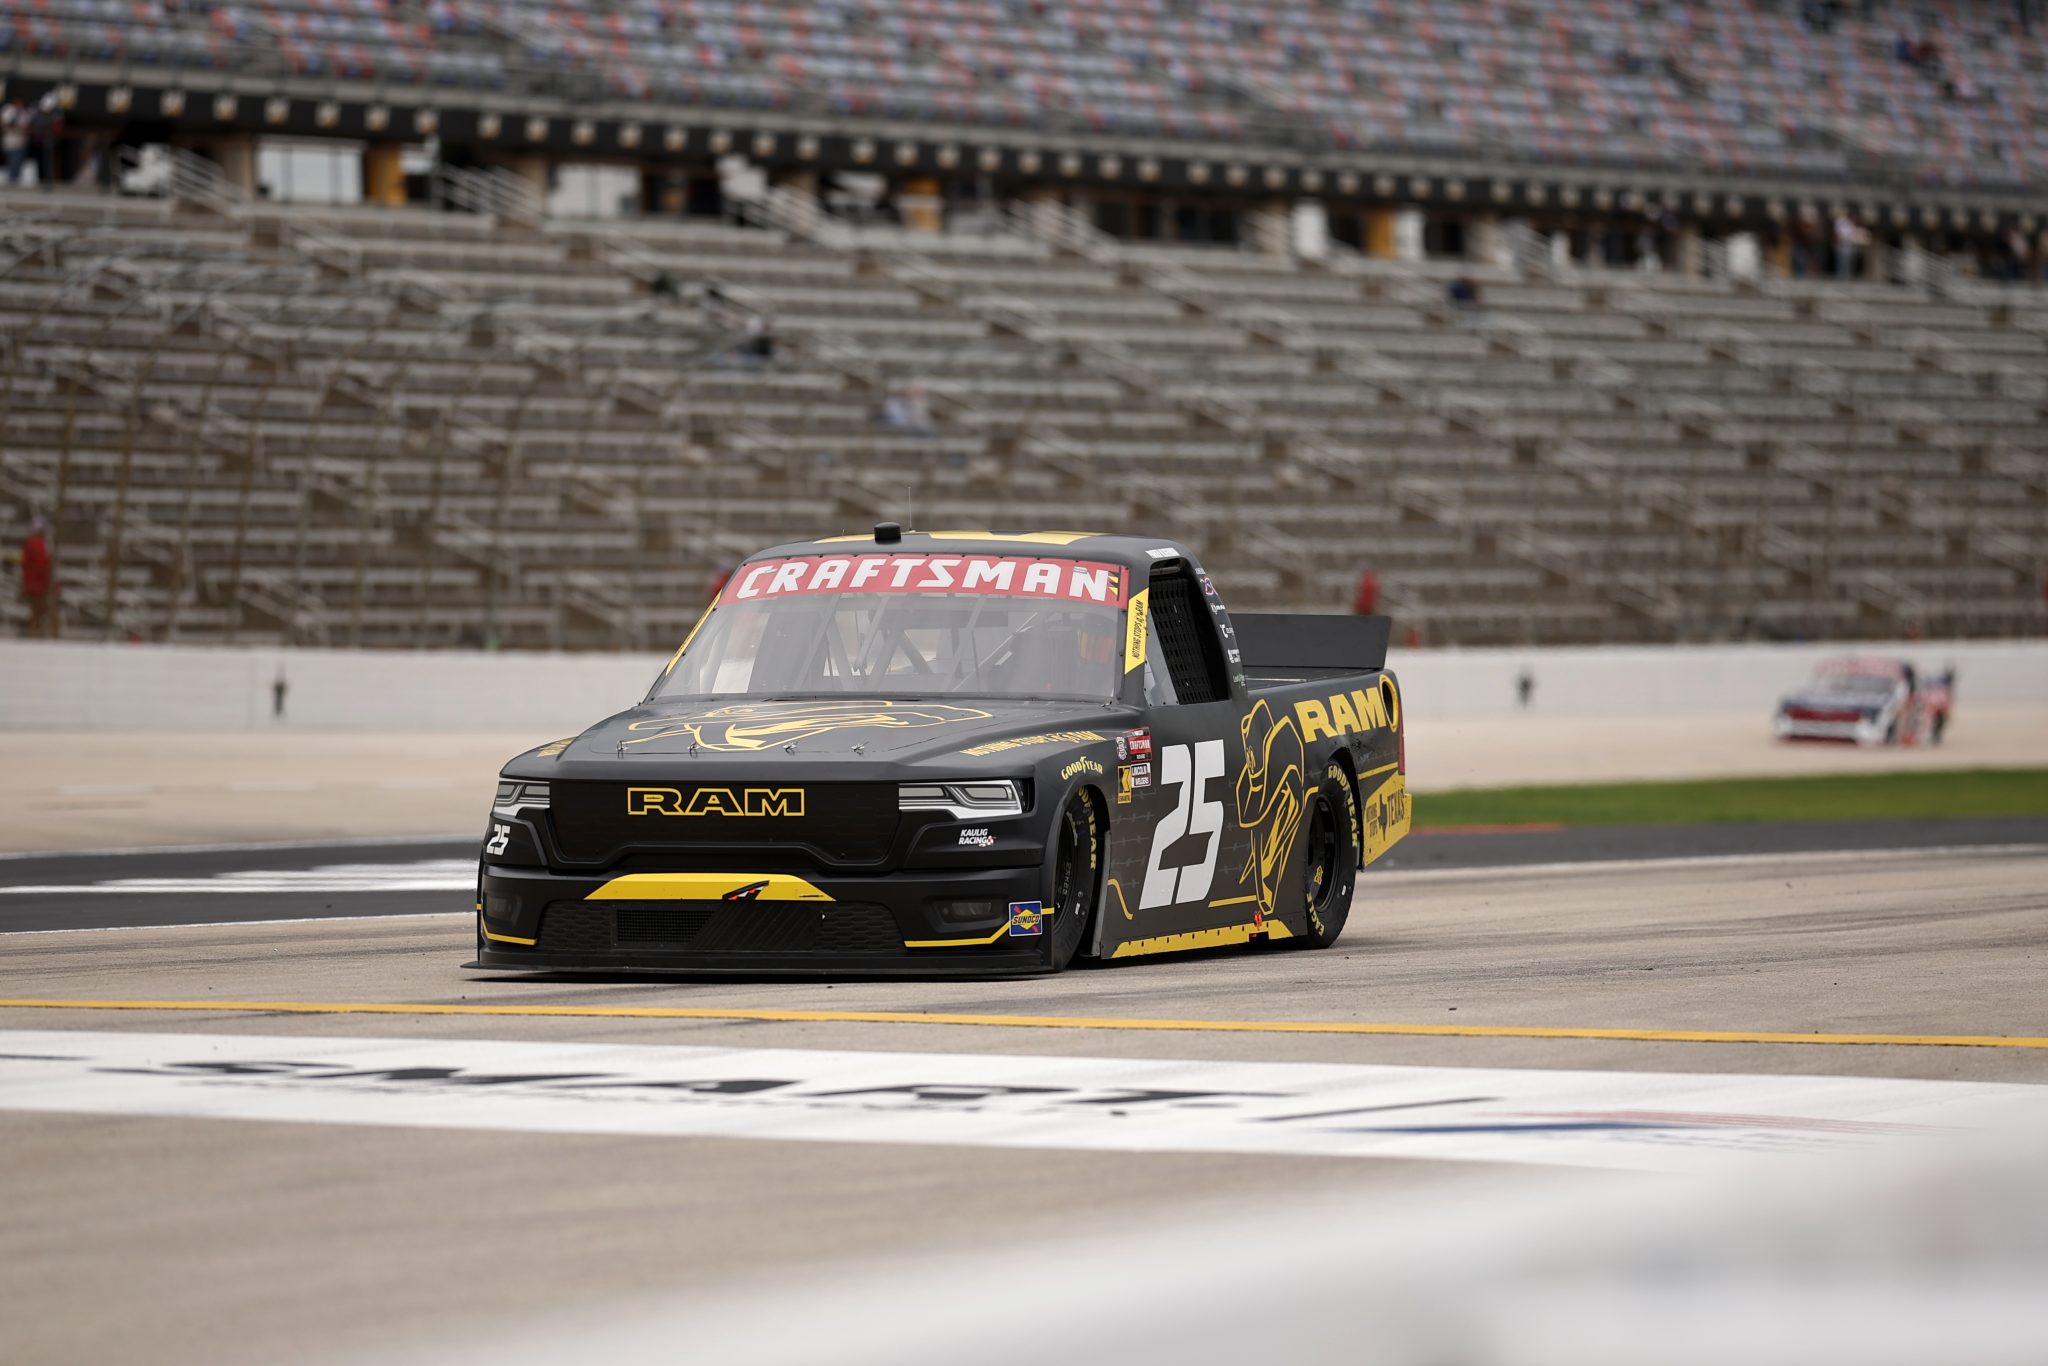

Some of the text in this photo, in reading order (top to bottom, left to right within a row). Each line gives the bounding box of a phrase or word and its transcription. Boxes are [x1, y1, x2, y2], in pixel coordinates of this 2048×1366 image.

[736, 557, 1111, 602] CRAFTSMAN
[1293, 687, 1387, 744] RAM
[1061, 756, 1103, 780] GOODYEAR
[627, 787, 806, 817] RAM
[1328, 765, 1358, 848] GOODYEAR
[486, 823, 511, 856] 25
[960, 828, 988, 837] KAULIG
[1139, 739, 1225, 910] 25
[958, 836, 988, 846] RACING
[1012, 914, 1040, 925] SUNOCO
